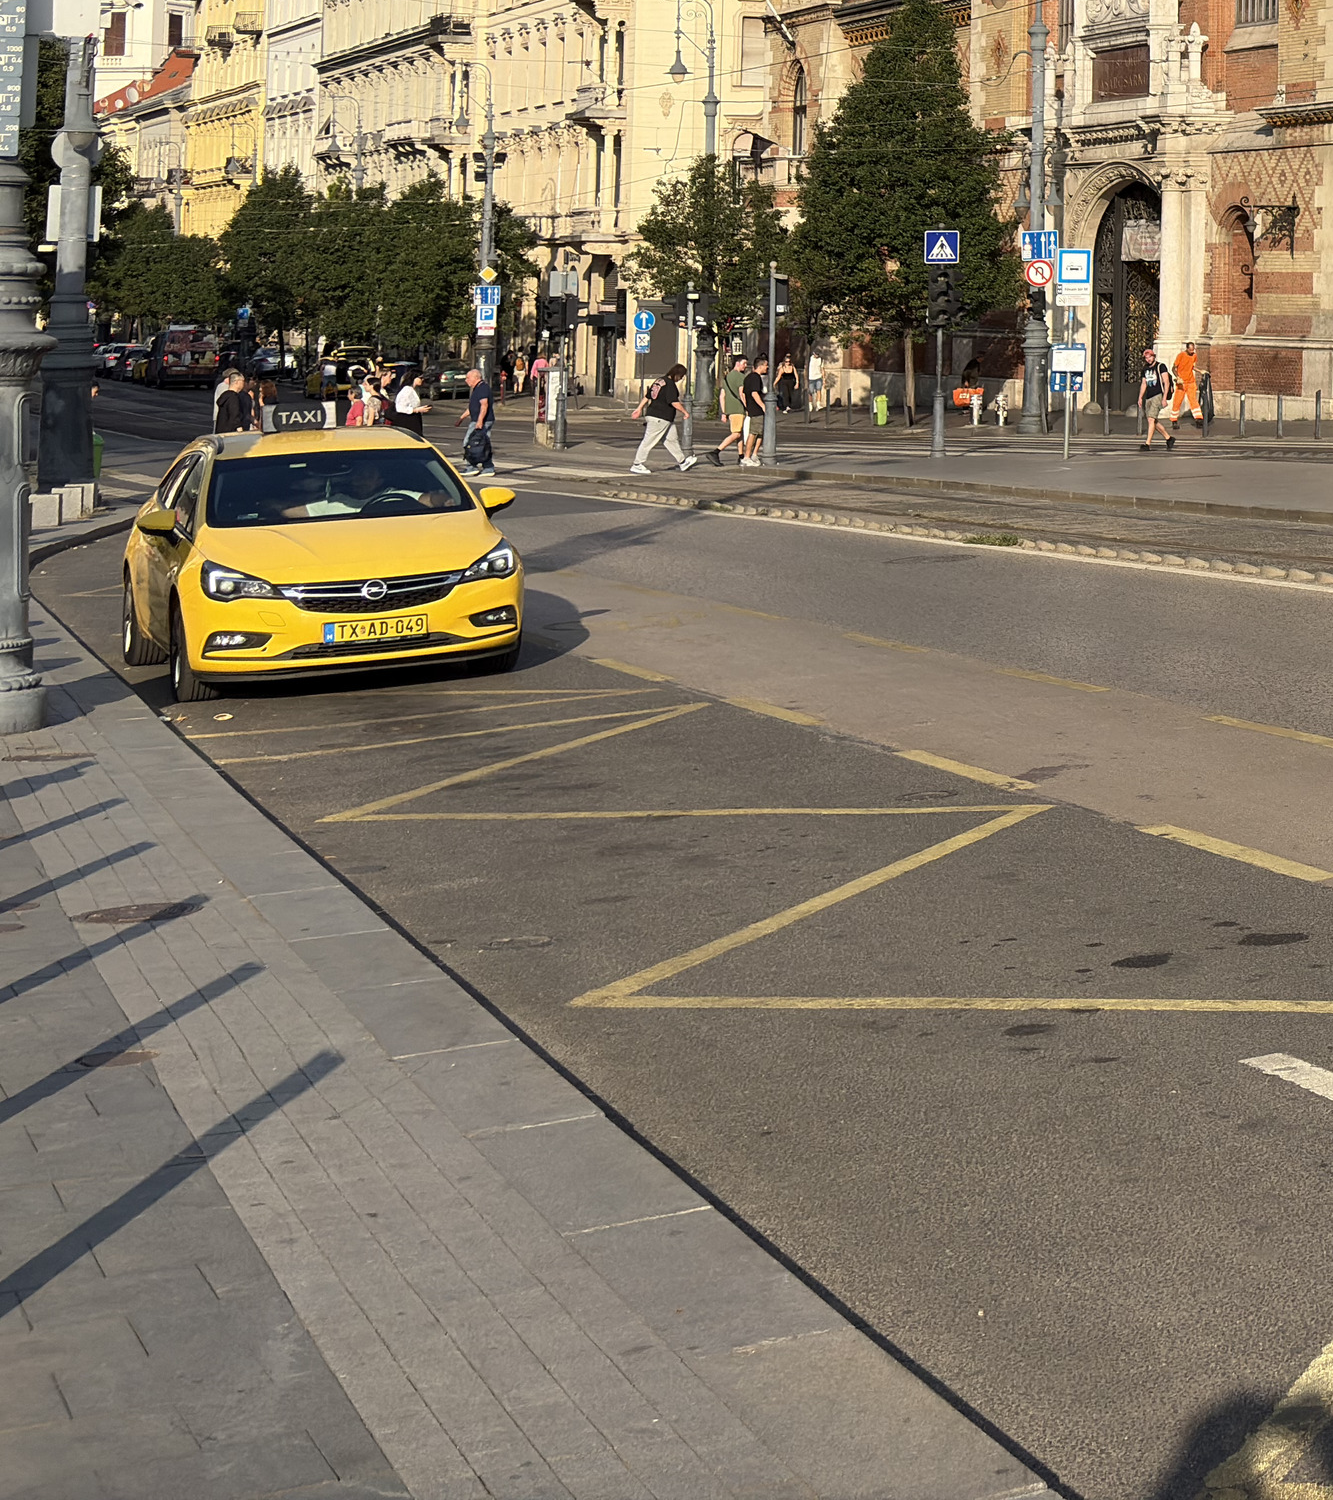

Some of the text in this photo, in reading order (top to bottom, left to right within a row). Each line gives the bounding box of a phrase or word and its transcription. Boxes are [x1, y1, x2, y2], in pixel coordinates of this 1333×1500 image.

[482, 309, 492, 320] P
[278, 410, 322, 425] TAXI
[338, 624, 359, 639] TX
[368, 617, 424, 637] AD-049
